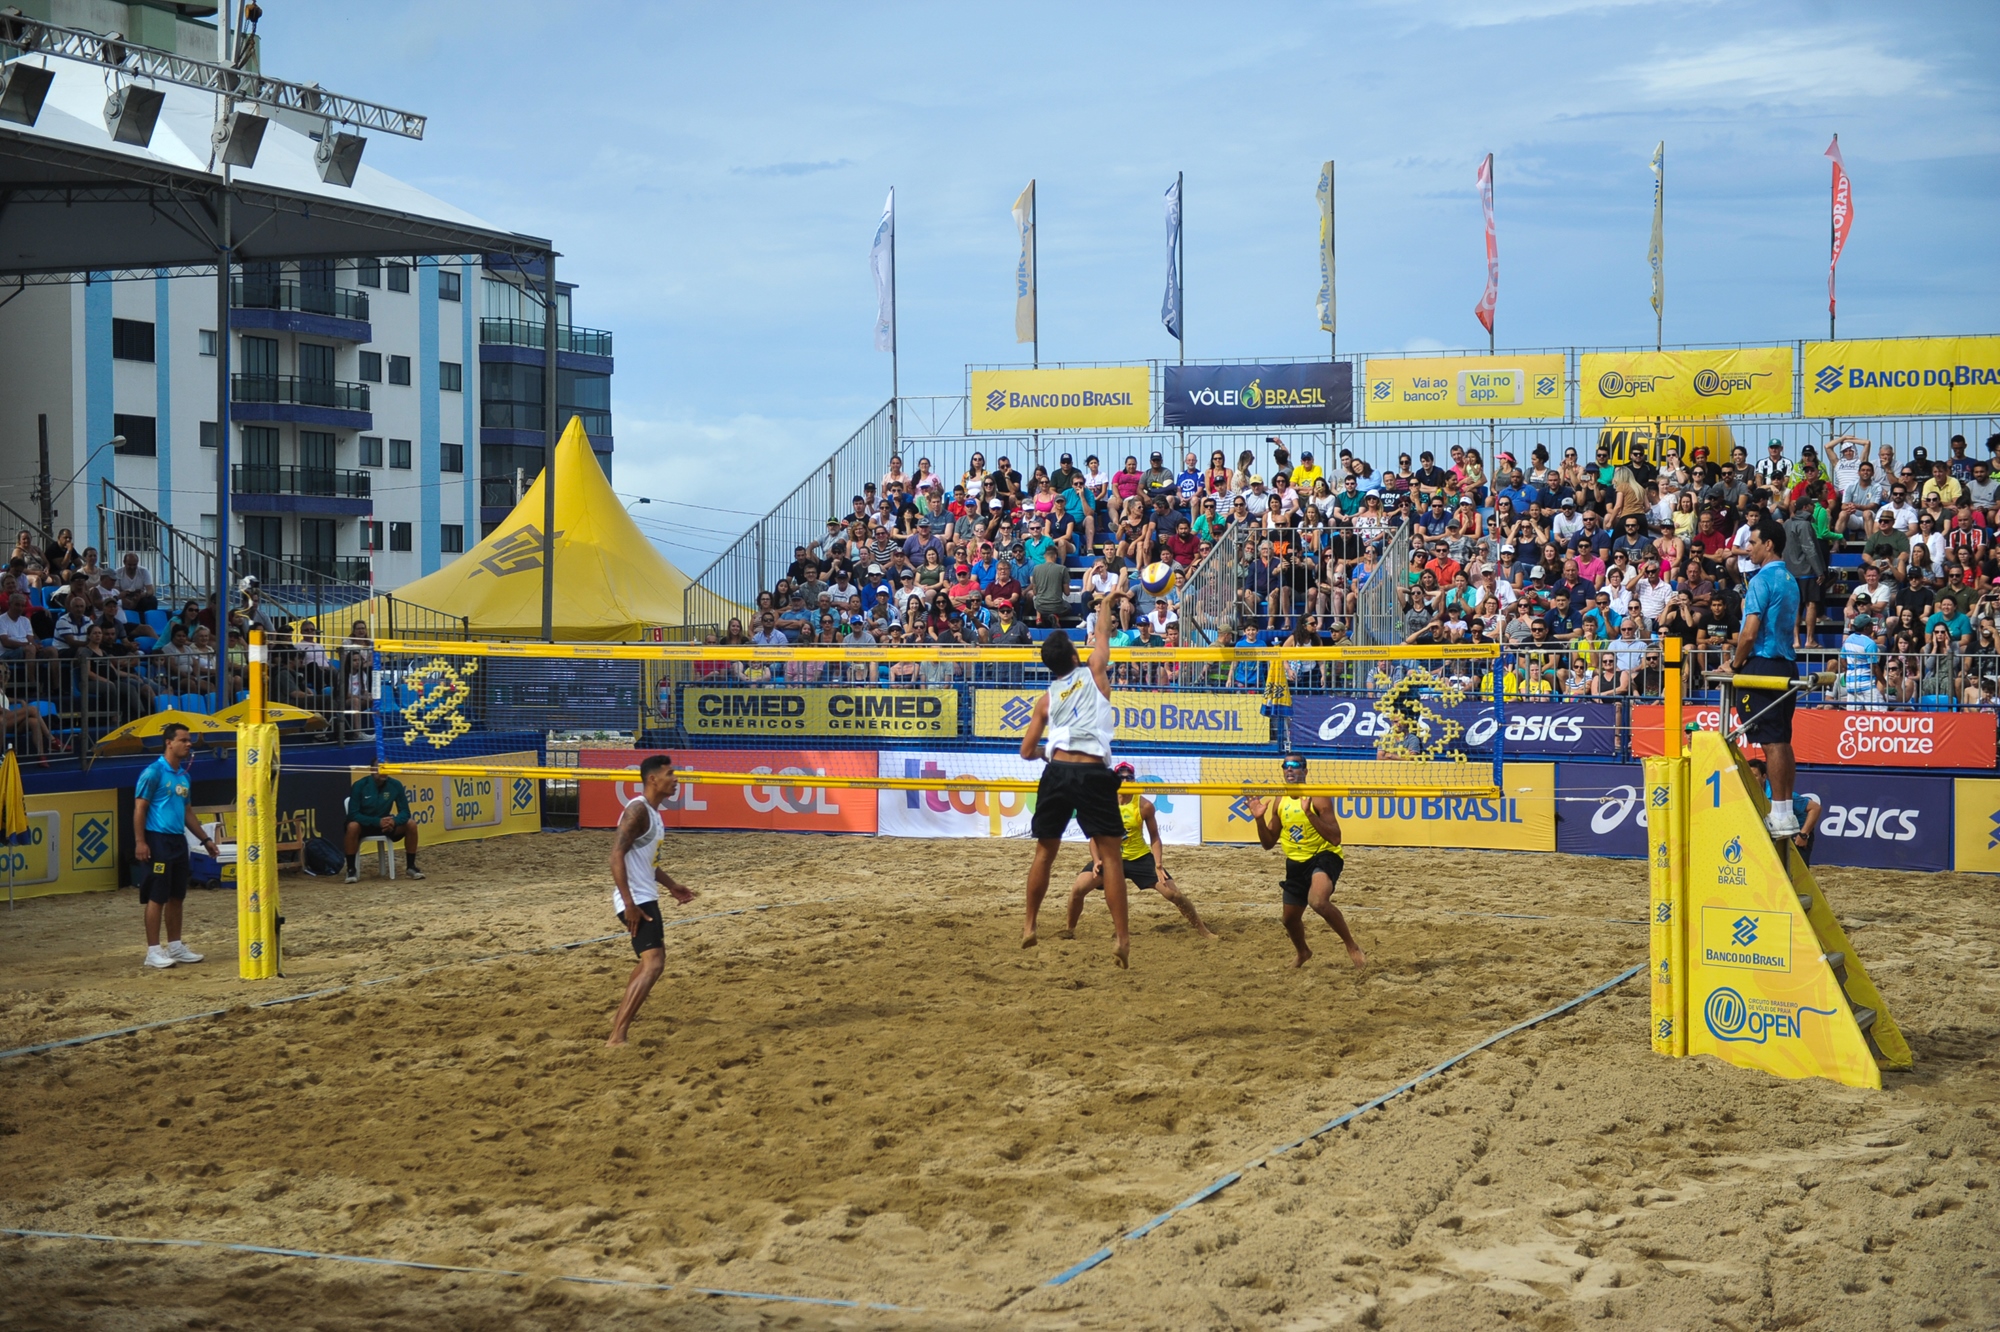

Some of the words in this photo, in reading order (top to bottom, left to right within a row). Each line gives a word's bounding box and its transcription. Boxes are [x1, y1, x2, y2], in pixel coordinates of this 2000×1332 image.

[1412, 377, 1431, 389] Vai
[1433, 379, 1448, 388] ao
[1470, 374, 1490, 387] Vai
[1493, 375, 1511, 387] no
[1720, 379, 1751, 391] OPEN
[1849, 366, 1920, 388] BANCO
[1923, 369, 1951, 387] DO
[1955, 365, 2000, 386] BRA
[1188, 387, 1238, 406] VÔLEI
[1265, 388, 1326, 405] BRASIL
[1403, 389, 1448, 402] banco?
[1470, 388, 1498, 401] app.
[1624, 381, 1654, 393] OPEN
[1009, 392, 1059, 408] BANCO
[1061, 393, 1081, 407] DO
[1082, 390, 1133, 407] BRASIL
[697, 693, 806, 718] CIMED
[827, 694, 942, 718] CIMED
[697, 716, 806, 729] GENÉRICOS
[828, 717, 942, 731] GENÉRICOS
[1125, 707, 1156, 729] DO
[1160, 703, 1243, 732] BRASIL
[1843, 715, 1934, 734] cenoura
[403, 784, 417, 803] ai
[419, 787, 434, 802] ao
[453, 777, 473, 798] Vai
[476, 779, 491, 796] no
[615, 765, 707, 811] GL
[743, 766, 839, 815] GOL
[1705, 769, 1721, 808] 1
[456, 800, 482, 821] app.
[1378, 797, 1416, 820] DO
[1421, 797, 1523, 824] BRASIL
[278, 808, 322, 843] ASIL
[1717, 875, 1748, 886] BRASIL
[1706, 948, 1738, 963] BANCO
[1740, 953, 1752, 964] DO
[1752, 953, 1786, 967] BRASIL
[1748, 998, 1769, 1006] CIRCUITO
[1770, 1000, 1798, 1008] BRASILEIRO
[1748, 1011, 1801, 1039] OPEN
